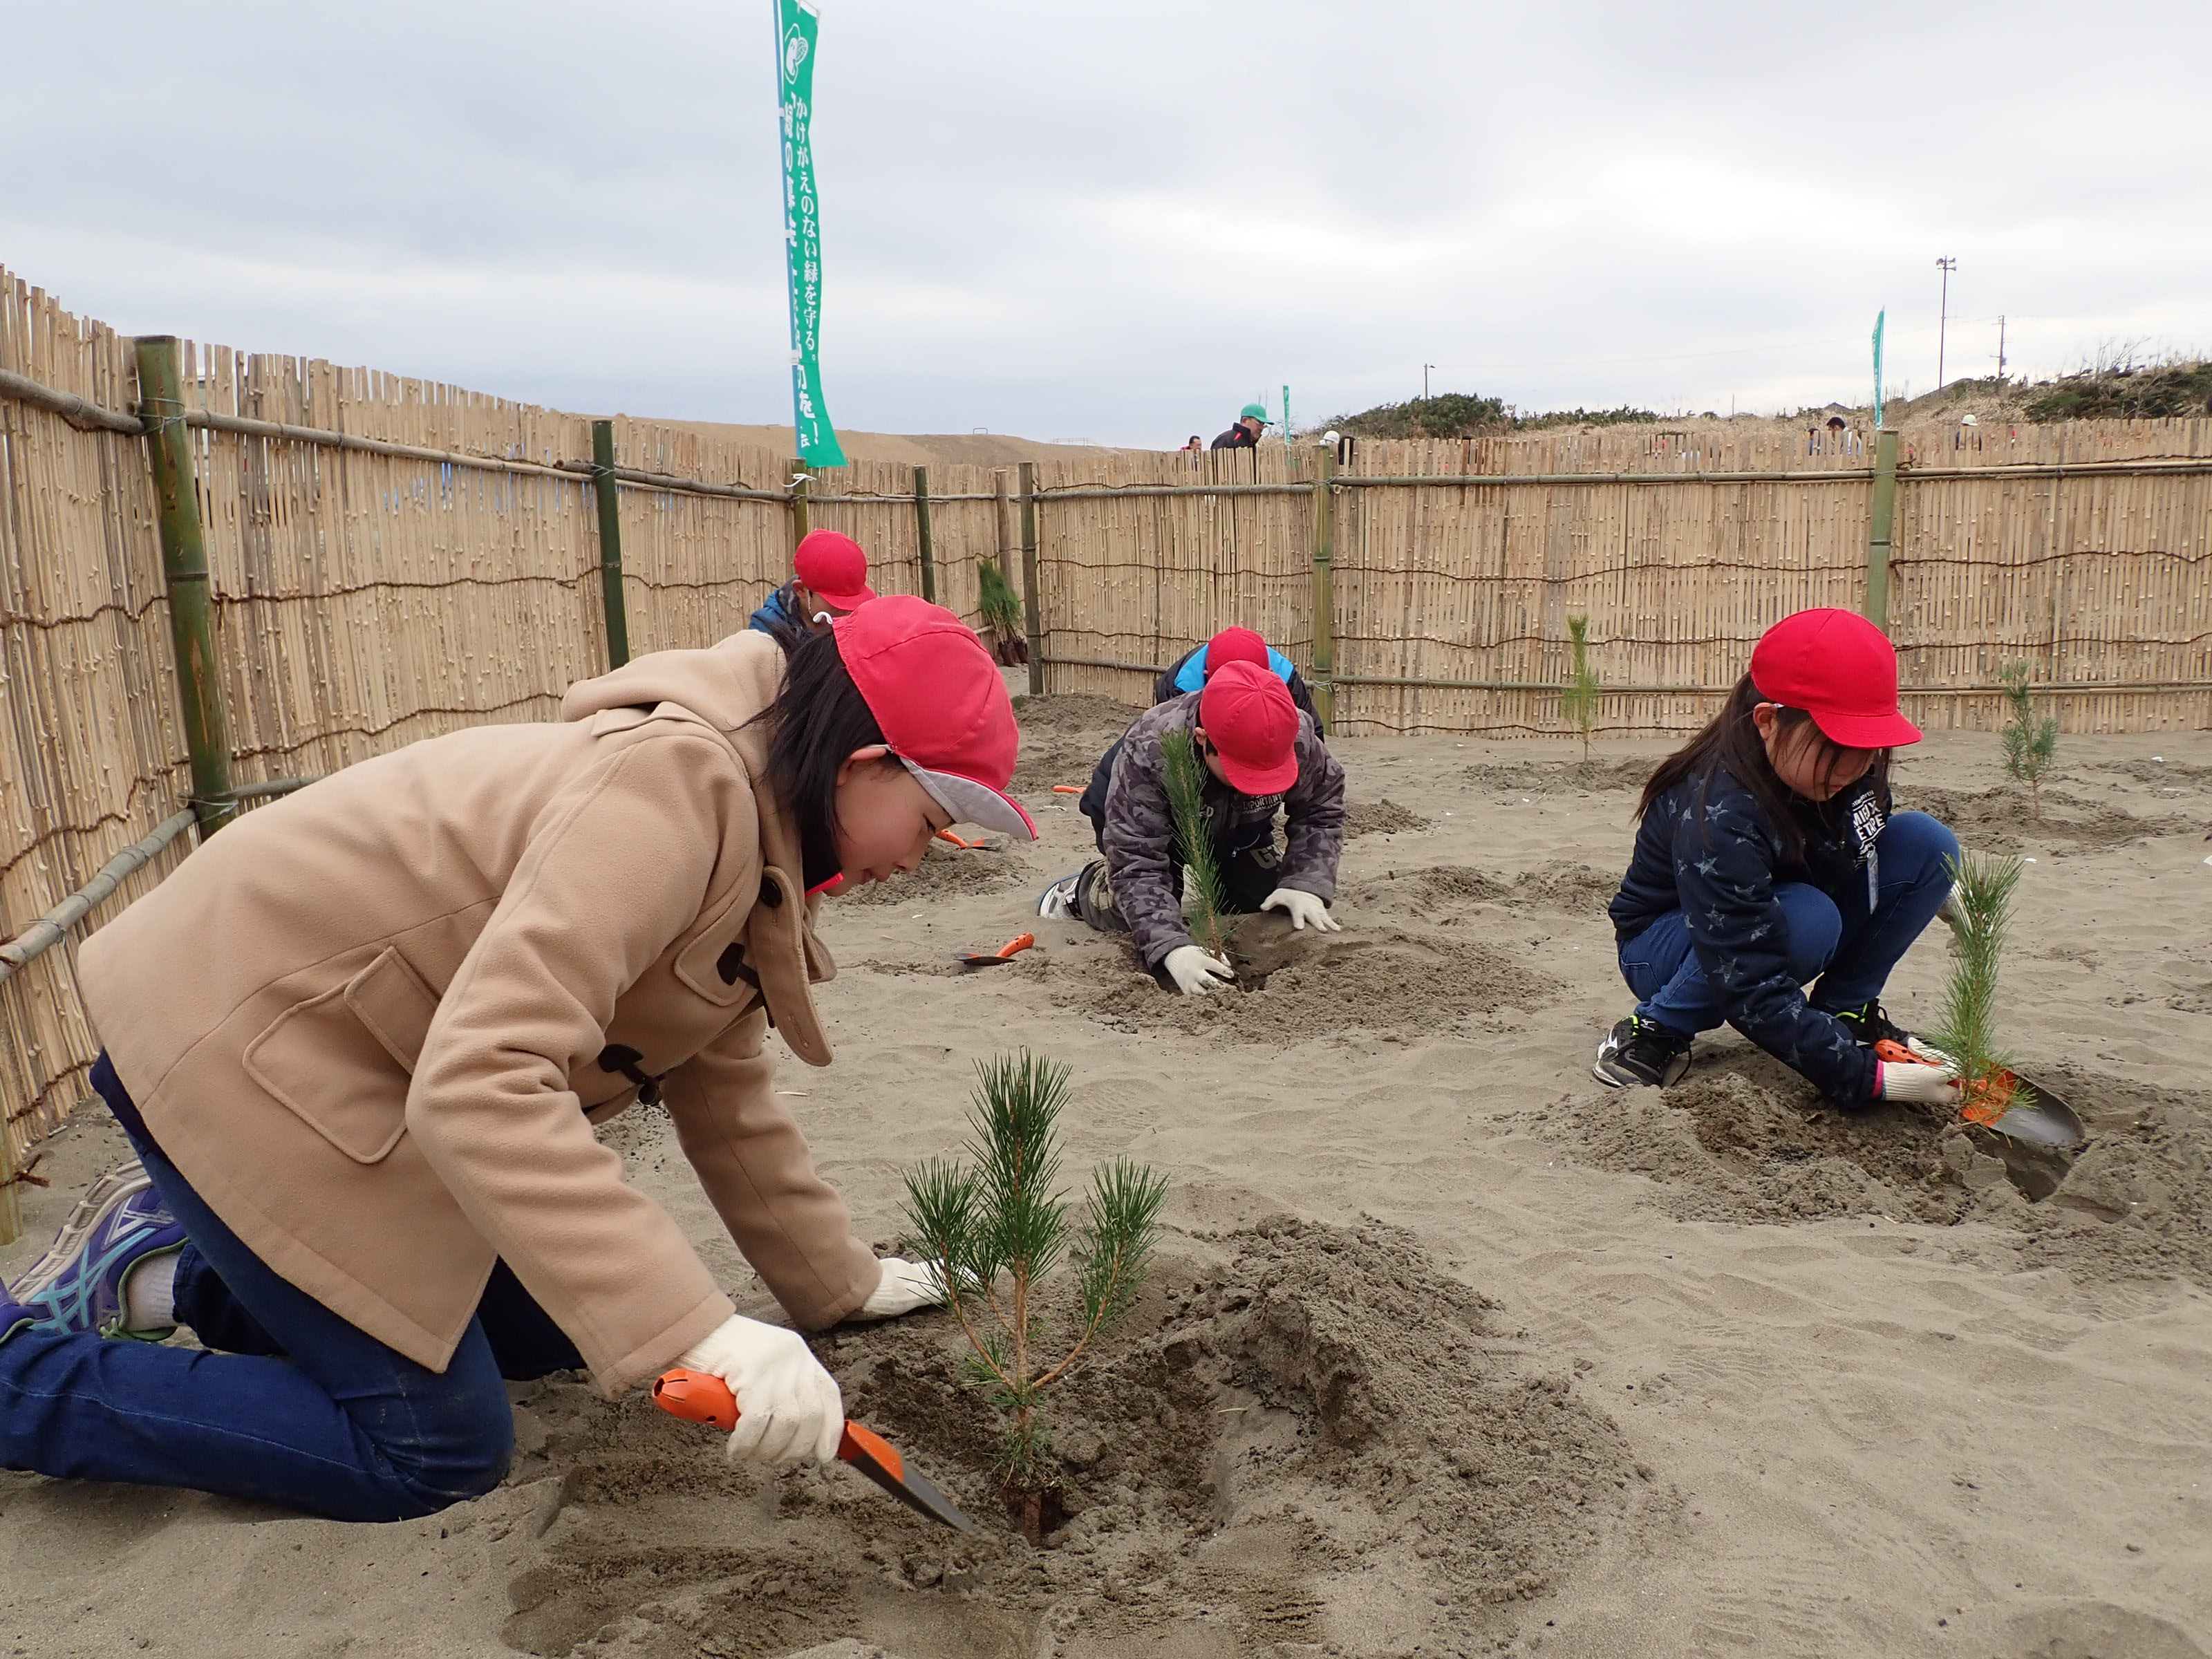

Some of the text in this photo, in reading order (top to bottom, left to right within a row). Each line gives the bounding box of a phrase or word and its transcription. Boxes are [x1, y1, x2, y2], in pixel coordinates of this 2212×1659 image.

[796, 96, 818, 362] かけがえのない緑を守る。
